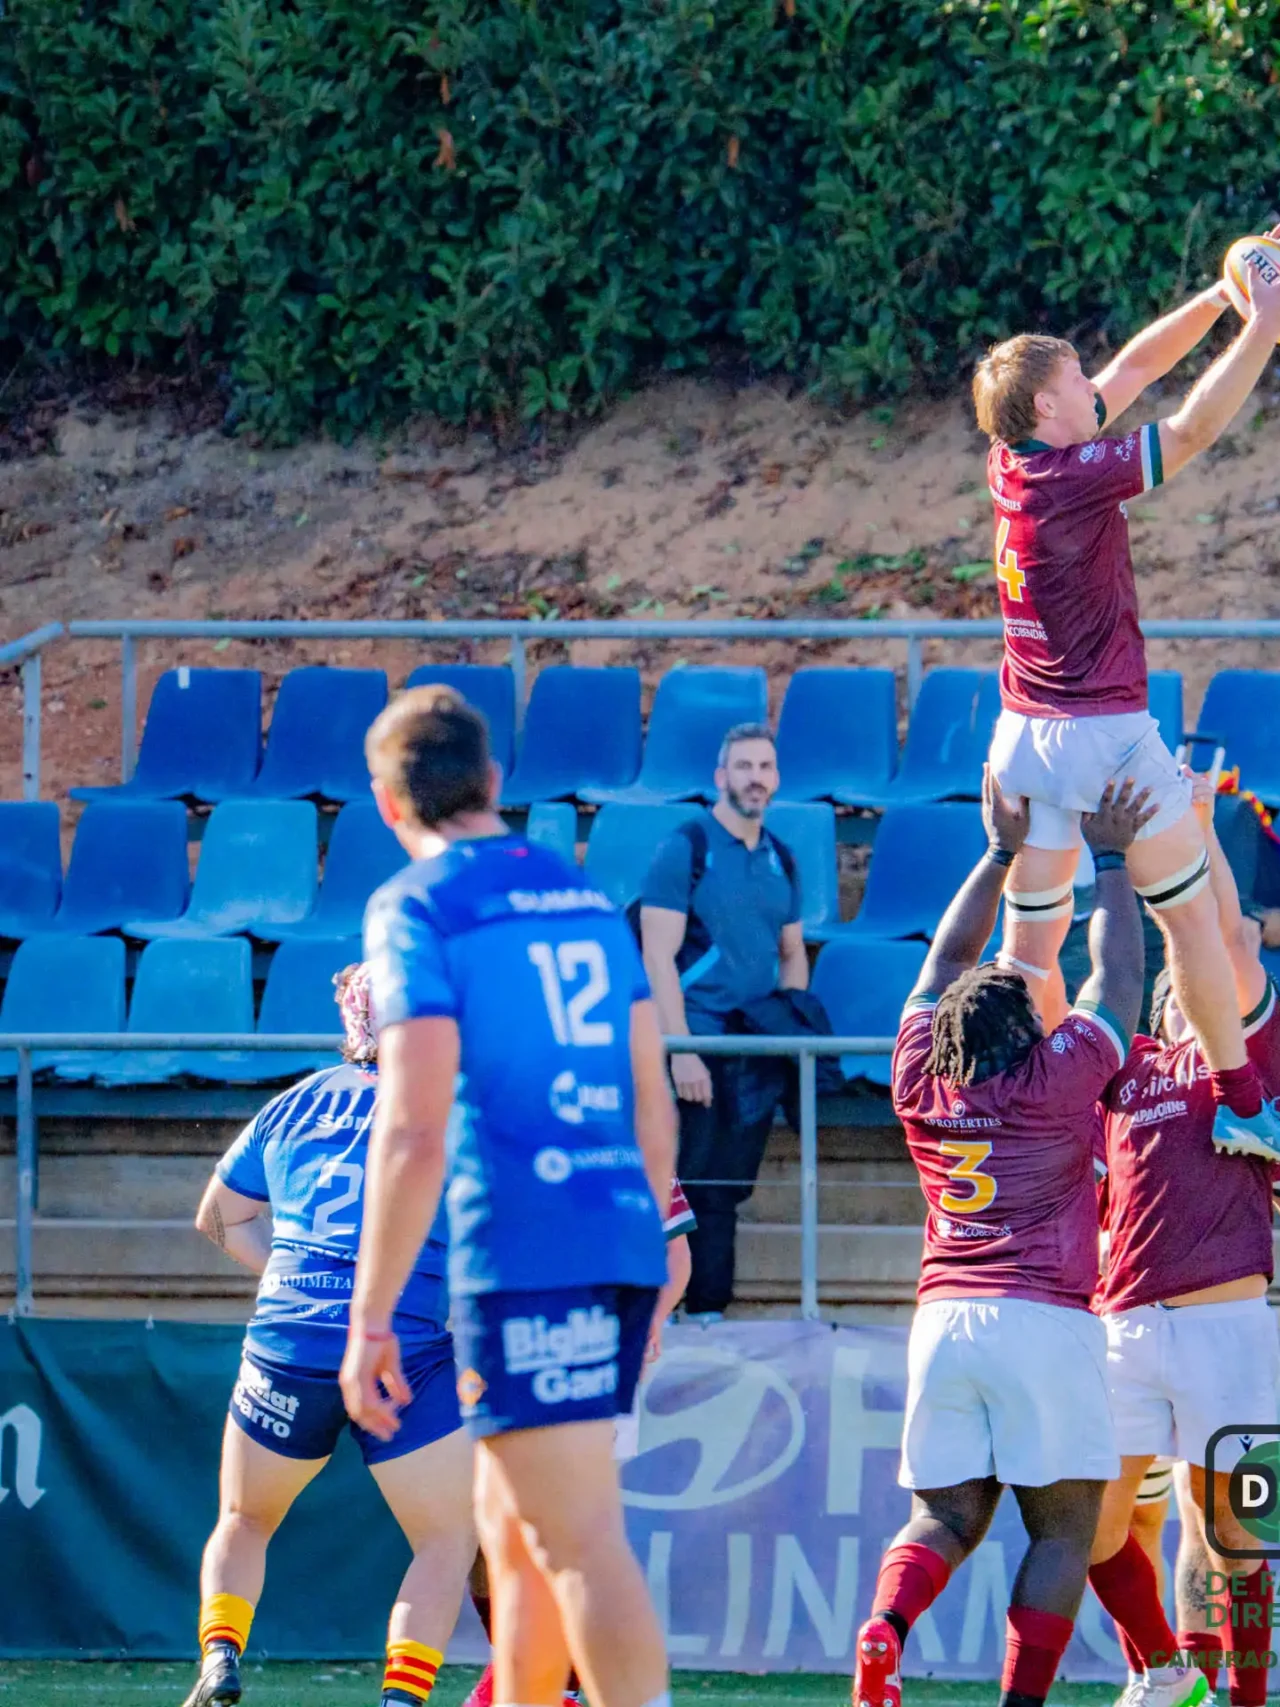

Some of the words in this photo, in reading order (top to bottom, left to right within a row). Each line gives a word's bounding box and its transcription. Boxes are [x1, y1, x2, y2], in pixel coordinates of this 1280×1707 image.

[996, 518, 1027, 603] 4
[527, 940, 614, 1046] 12
[312, 1162, 365, 1237] 2
[939, 1139, 998, 1214] 3
